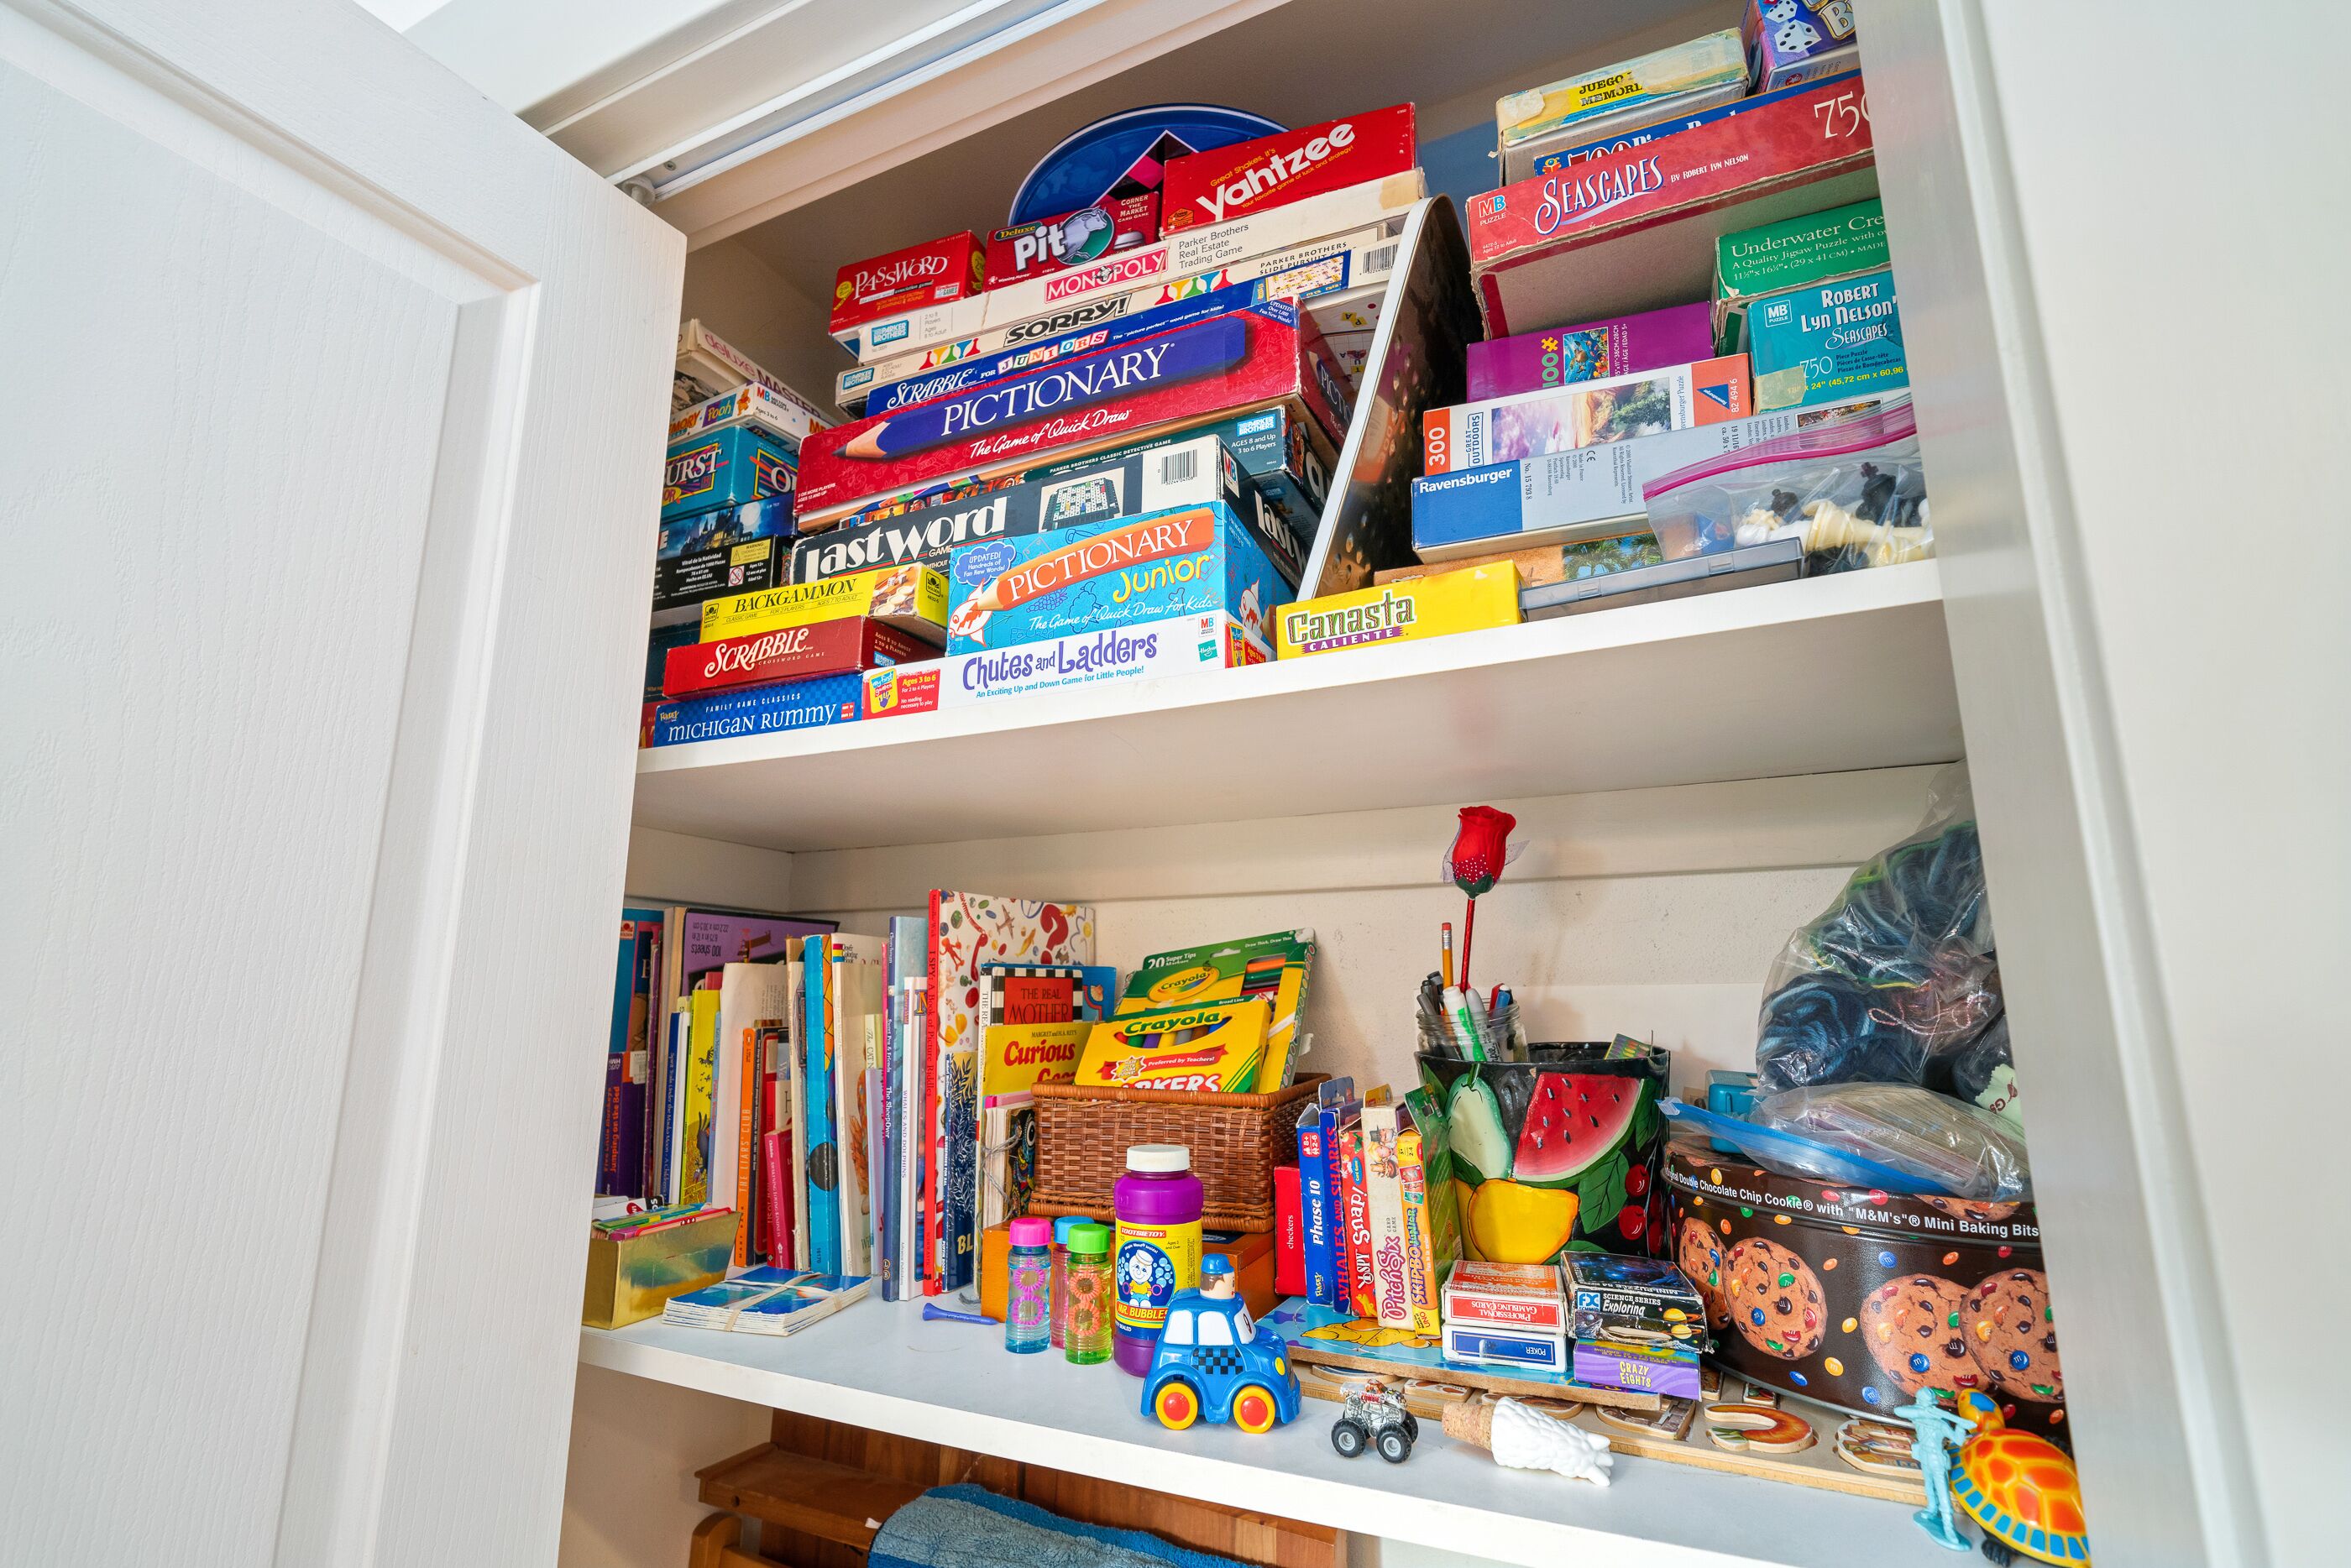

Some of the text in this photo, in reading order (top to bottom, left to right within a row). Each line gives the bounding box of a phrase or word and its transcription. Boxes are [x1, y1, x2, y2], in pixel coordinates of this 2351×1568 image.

[1579, 75, 1624, 95] JUEGO
[1241, 197, 1254, 208] Your
[1255, 187, 1276, 202] favorite
[1277, 179, 1294, 192] game
[1302, 166, 1315, 177] luck
[1315, 159, 1327, 170] and
[1328, 145, 1354, 164] strategy!
[1120, 206, 1148, 217] MARKET
[1121, 195, 1149, 206] CORNER
[1479, 195, 1506, 217] MB
[1479, 212, 1506, 226] PUZZLE
[1000, 225, 1036, 238] Deluxe
[1179, 223, 1249, 249] Parker Brothers
[1732, 223, 1841, 258] Underwater
[1014, 224, 1066, 271] Pit
[1179, 238, 1229, 259] Real Estate
[1180, 245, 1243, 269] Trading Game
[1260, 242, 1347, 268] PARKER BROTHERS
[1733, 231, 1874, 269] A Quality Jigsaw Puzzle with
[853, 256, 948, 299] PASSWORD
[1048, 252, 1166, 300] MONOPOLY
[1821, 283, 1879, 309] ROBERT
[1005, 294, 1131, 345] SORRY!
[1767, 304, 1788, 316] MB
[1825, 323, 1888, 350] SEASCAPES
[705, 333, 755, 376] deluxe
[1851, 350, 1868, 358] Puzzle
[1862, 357, 1901, 369] Rompecabezas
[757, 386, 770, 402] MB
[941, 342, 1172, 436] PICTIONARY
[708, 400, 731, 419] Pooh
[1238, 425, 1275, 436] BROTHERS
[1249, 415, 1275, 427] PARKER
[970, 409, 1129, 459] The Game of Quick Draw
[1471, 415, 1480, 464] OUTDOORS
[1071, 457, 1099, 469] BROTHERS
[1099, 450, 1122, 462] CLASSIC
[1123, 444, 1154, 456] DETECTIVE
[1155, 439, 1171, 448] GAME
[1428, 426, 1446, 467] 300
[1420, 468, 1512, 494] Ravensburger
[969, 551, 1001, 563] UPDATED!
[1008, 520, 1193, 602] PICTIONARY
[1113, 556, 1210, 603] Junior
[734, 578, 857, 614] BACKGAMMON
[725, 614, 744, 623] CLASSIC
[1029, 594, 1212, 631] The Game of Quick Draw for Kids
[1200, 617, 1214, 629] MB
[1285, 589, 1416, 646] Canasta
[1310, 630, 1394, 651] CALIENTE
[704, 628, 809, 678] SCRABBLE
[758, 655, 801, 666] CROSSWORD
[963, 632, 1158, 691] Chutes and Ladders
[976, 666, 1144, 698] An Exciting Up and Down Game for Little People!
[705, 693, 801, 713] FAMILY GAME CLASSICS
[690, 943, 721, 957] 100 sheets
[1147, 956, 1165, 970] 20
[1165, 954, 1184, 963] Super
[1160, 971, 1208, 992] Crayola
[1021, 988, 1061, 1000] THE REAL
[1009, 1003, 1070, 1023] MOTHER
[1123, 1011, 1221, 1036] Crayola
[1003, 1039, 1076, 1066] Curious
[1148, 1057, 1176, 1067] Preferred
[742, 1108, 751, 1128] CLUB
[1312, 1180, 1325, 1247] Phase 10
[1326, 1126, 1349, 1301] WHALES AND SHARKS
[1351, 1186, 1370, 1246] Snap!
[1679, 1173, 1699, 1189] Double
[1699, 1178, 1738, 1199] Chocolate
[1740, 1189, 1762, 1205] Chip
[1817, 1202, 1845, 1217] with
[1924, 1215, 1955, 1232] Mini
[1959, 1219, 2008, 1238] Baking
[2013, 1222, 2039, 1238] Bits
[1122, 1227, 1165, 1237] TOOTSIETOY
[1118, 1303, 1128, 1315] MR.
[1471, 1299, 1537, 1315] GAMBLING CARDS
[1603, 1292, 1662, 1305] SCIENCE SERIES
[1479, 1308, 1532, 1323] PROFESSIONAL
[1526, 1346, 1546, 1356] POKER
[1620, 1361, 1650, 1377] CRAZY
